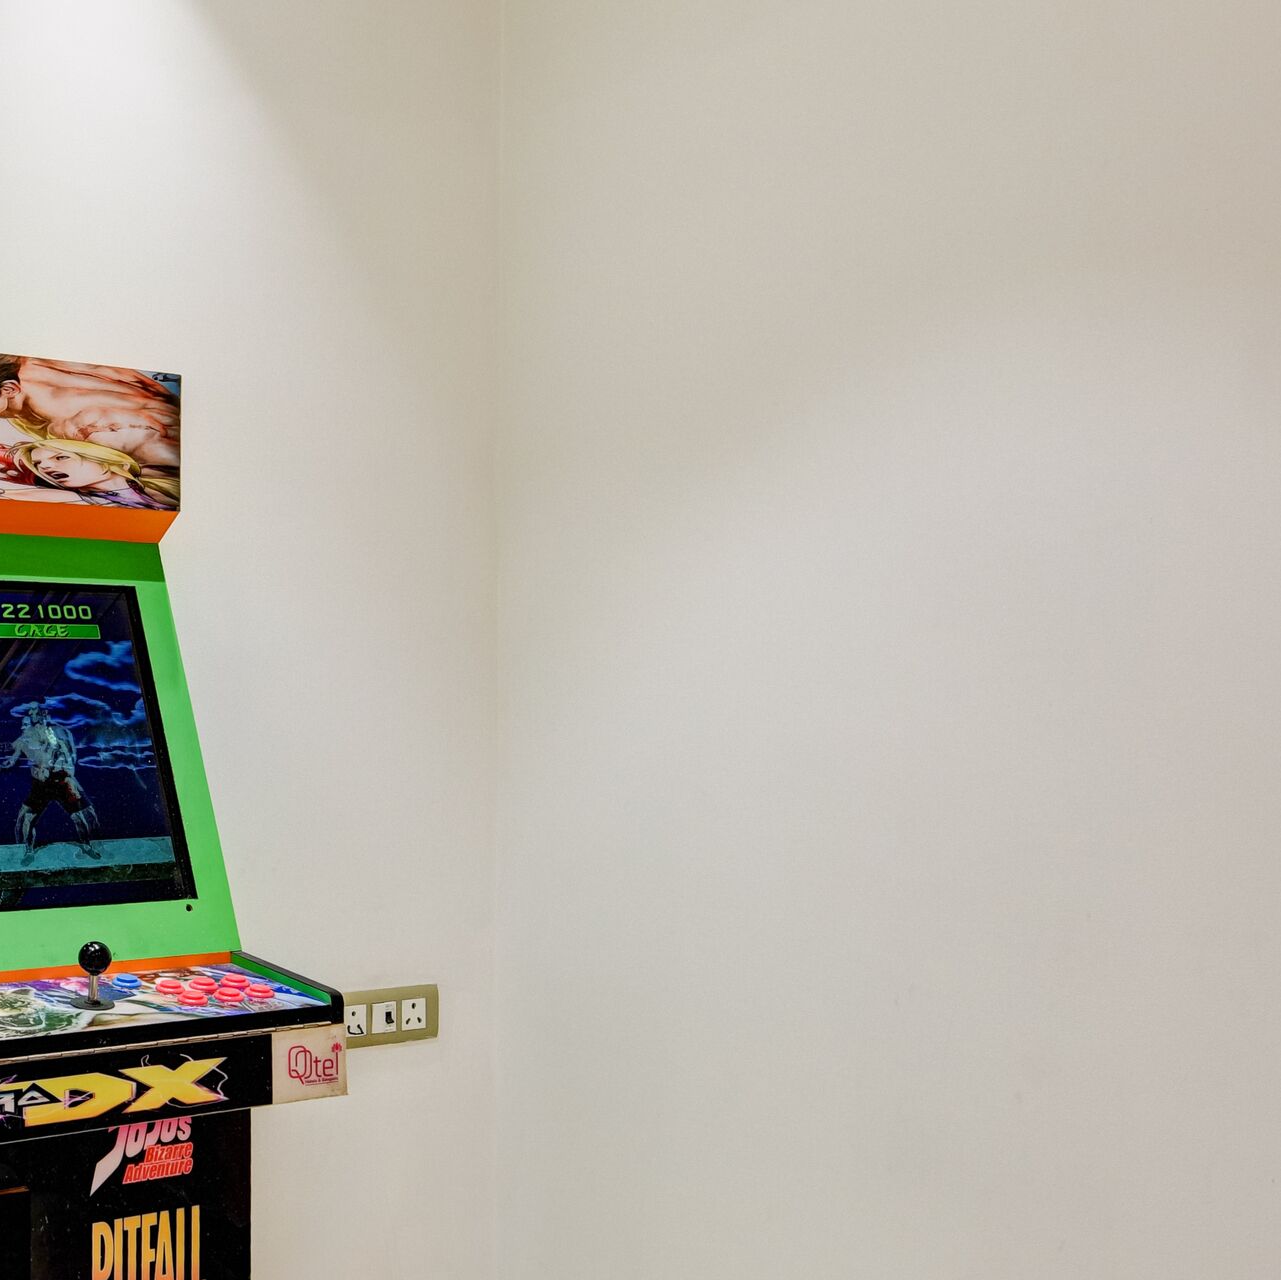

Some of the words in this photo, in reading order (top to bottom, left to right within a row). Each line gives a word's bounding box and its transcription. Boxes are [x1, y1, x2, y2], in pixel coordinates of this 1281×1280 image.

[1, 603, 92, 620] 221000
[15, 624, 70, 638] CAGE
[144, 1142, 194, 1164] Bizarre
[123, 1158, 194, 1185] Adventure
